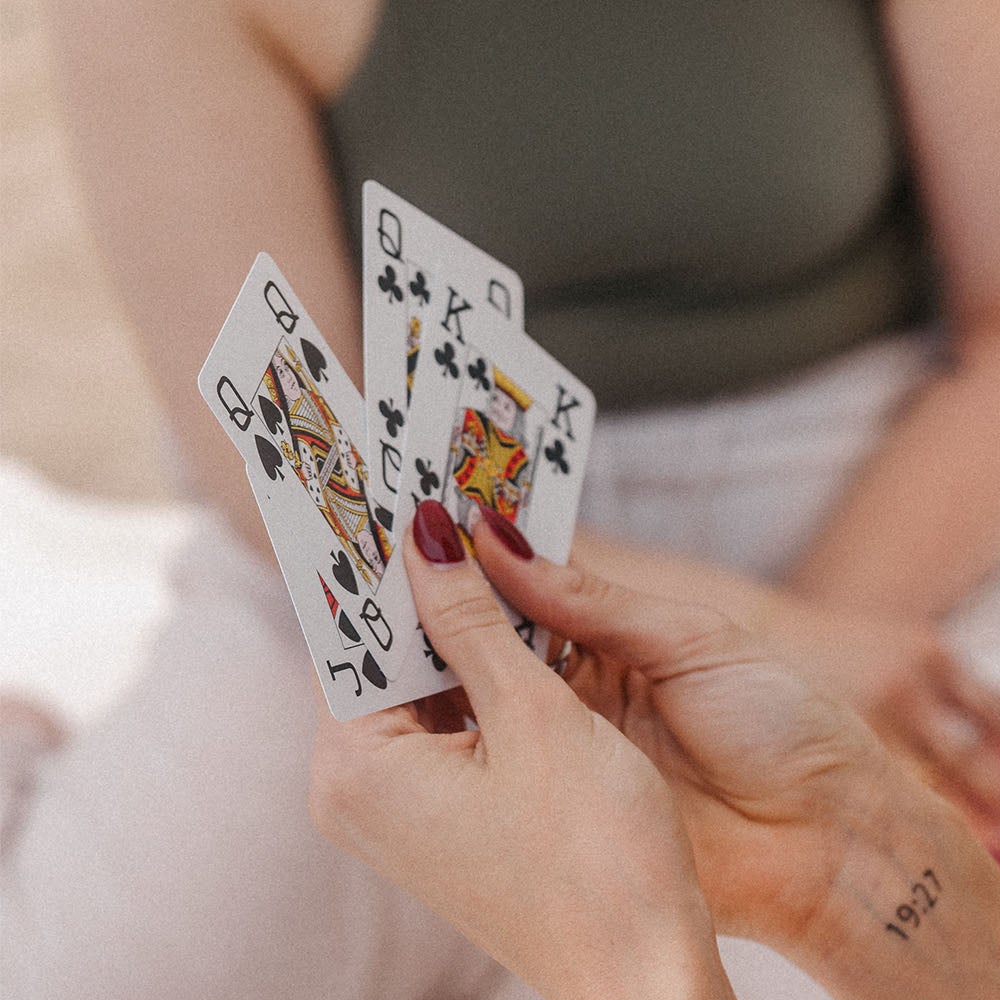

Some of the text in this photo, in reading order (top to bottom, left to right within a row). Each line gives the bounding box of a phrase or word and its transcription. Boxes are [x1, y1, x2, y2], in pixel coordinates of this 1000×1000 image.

[377, 208, 403, 259] Q
[264, 280, 299, 334] Q
[441, 286, 472, 345] K
[216, 375, 254, 432] Q
[550, 384, 580, 441] K
[359, 597, 393, 652] Q
[328, 660, 362, 697] J
[885, 869, 942, 941] 19:27
